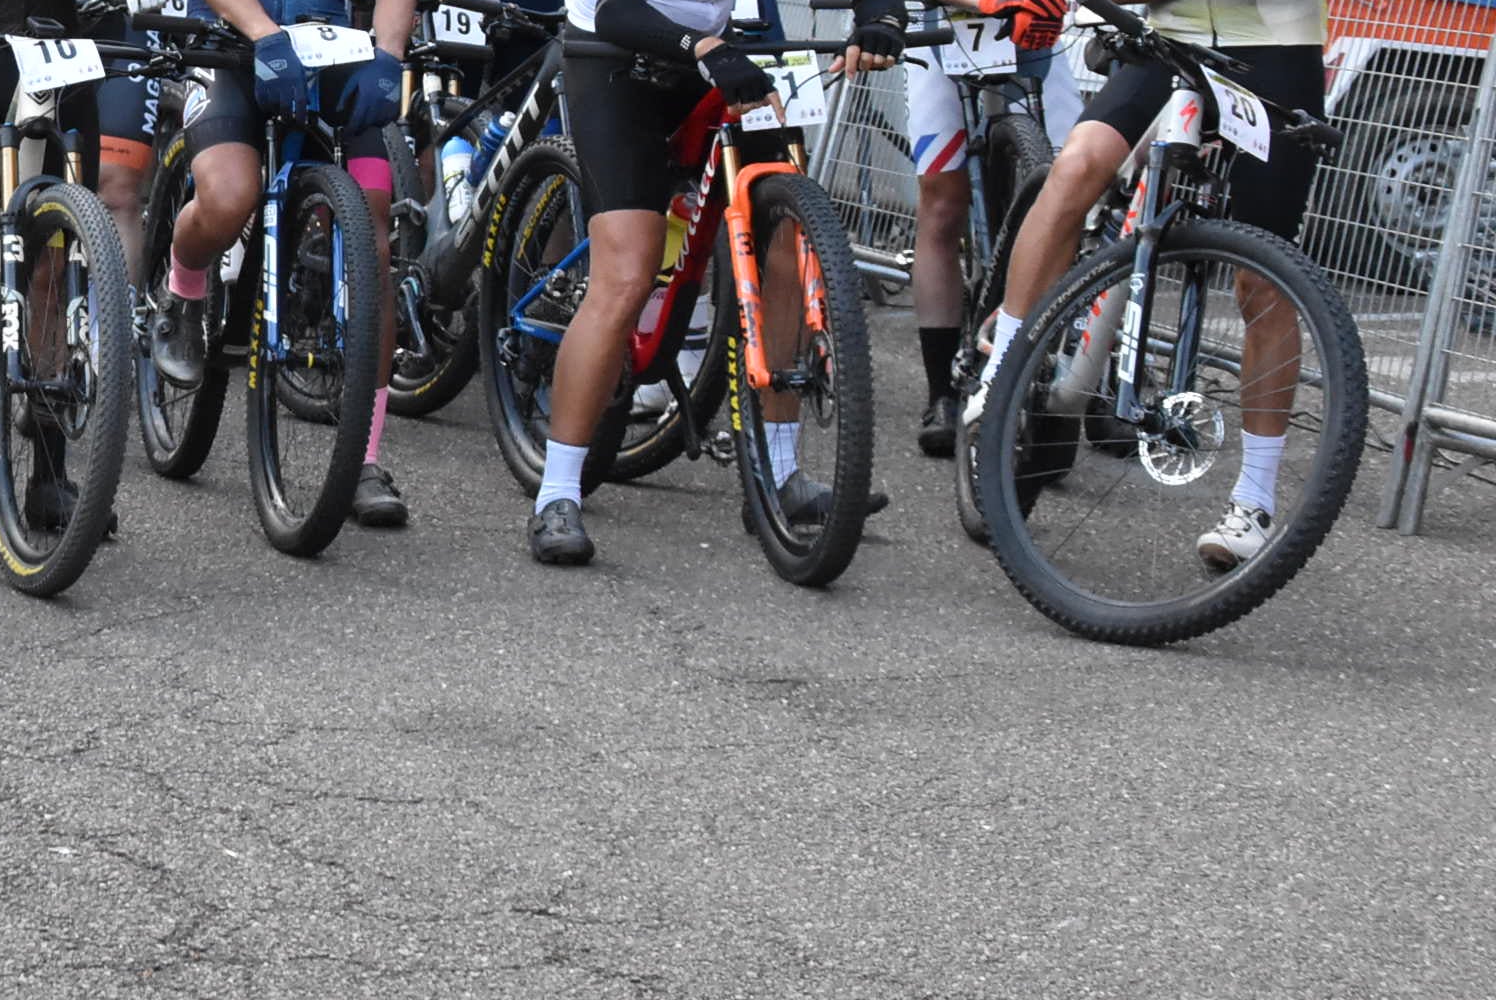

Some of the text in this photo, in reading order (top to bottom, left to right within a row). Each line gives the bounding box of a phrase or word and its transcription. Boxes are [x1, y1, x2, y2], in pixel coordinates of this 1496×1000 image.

[441, 8, 471, 35] 19
[967, 22, 985, 52] 7
[33, 40, 77, 64] 10
[1224, 90, 1257, 127] 20
[456, 82, 542, 248] SCOTT
[483, 193, 507, 268] MAXXIS
[247, 299, 264, 390] MAXXIS
[726, 336, 744, 432] MAXXIS
